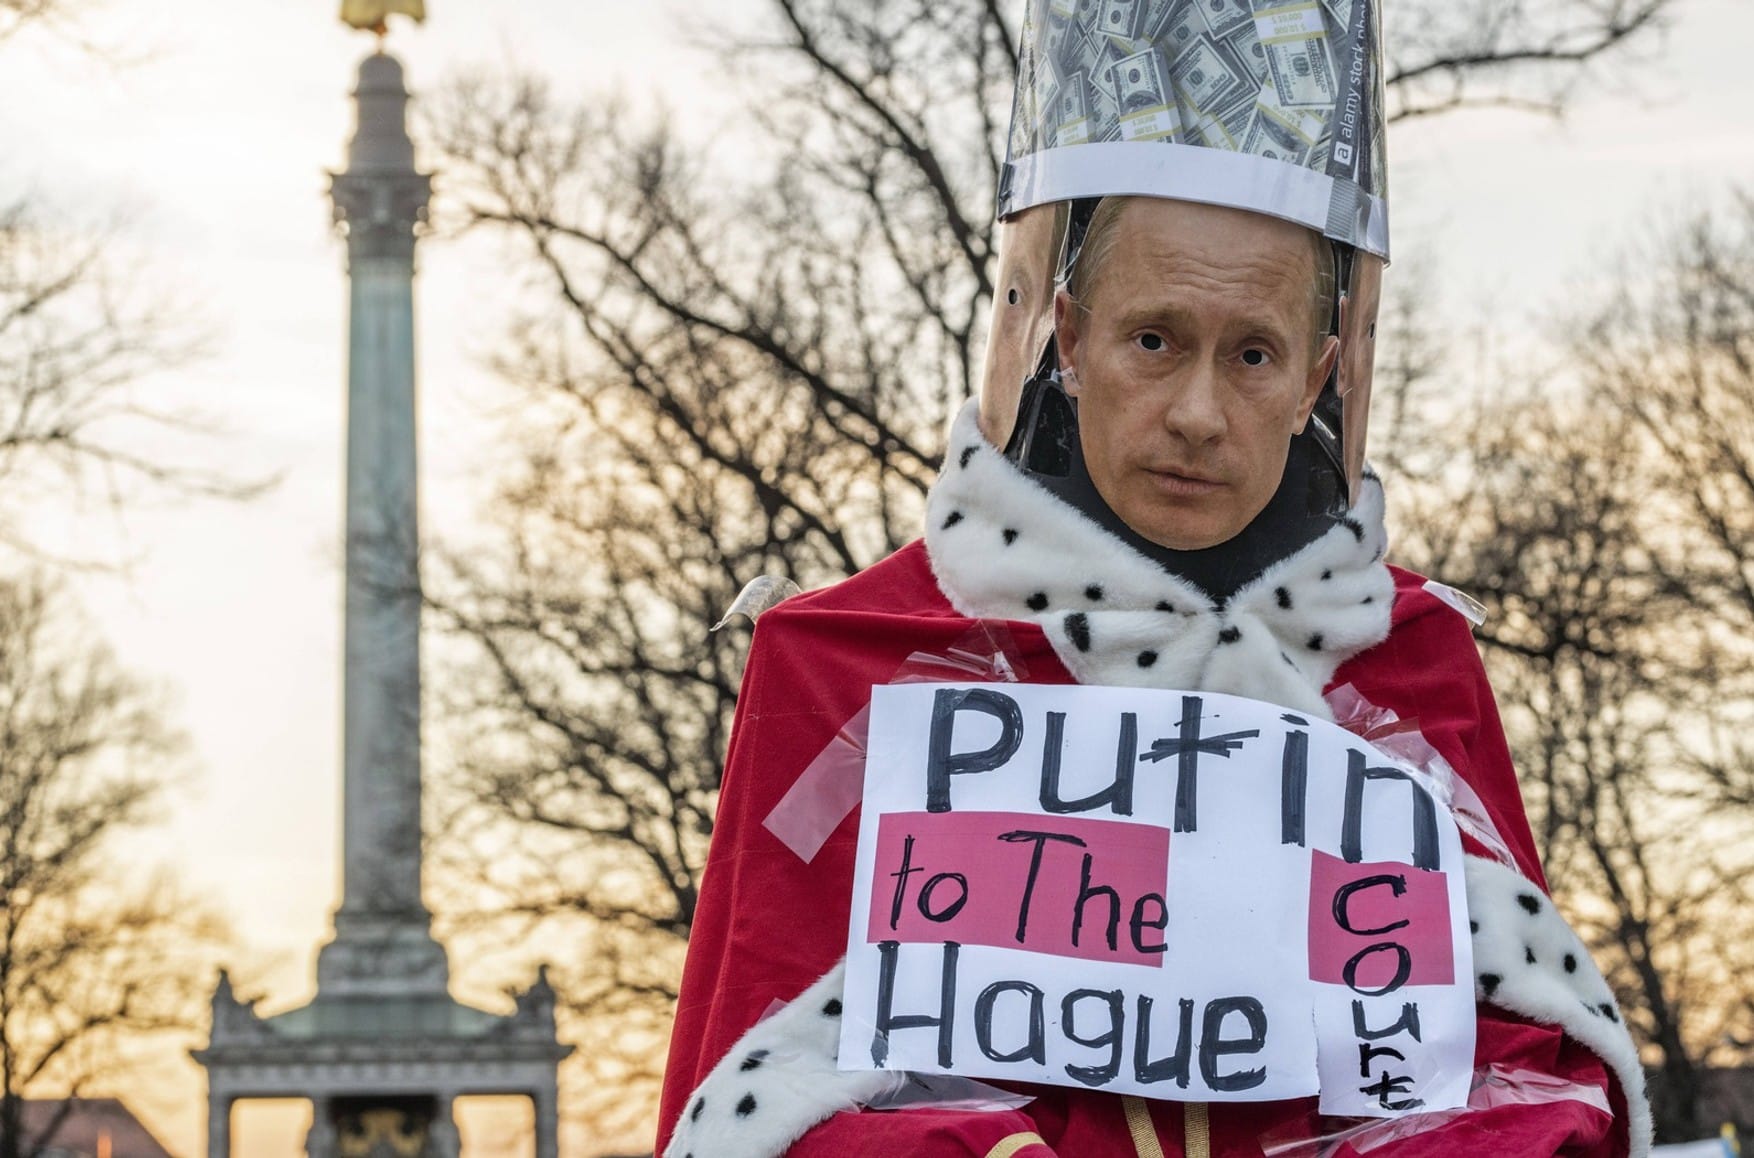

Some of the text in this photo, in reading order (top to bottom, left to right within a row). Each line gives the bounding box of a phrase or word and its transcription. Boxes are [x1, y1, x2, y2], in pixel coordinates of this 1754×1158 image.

[1339, 88, 1361, 139] alamy
[926, 688, 1441, 872] Putin
[891, 829, 1169, 953] to The
[871, 940, 1268, 1092] Hague
